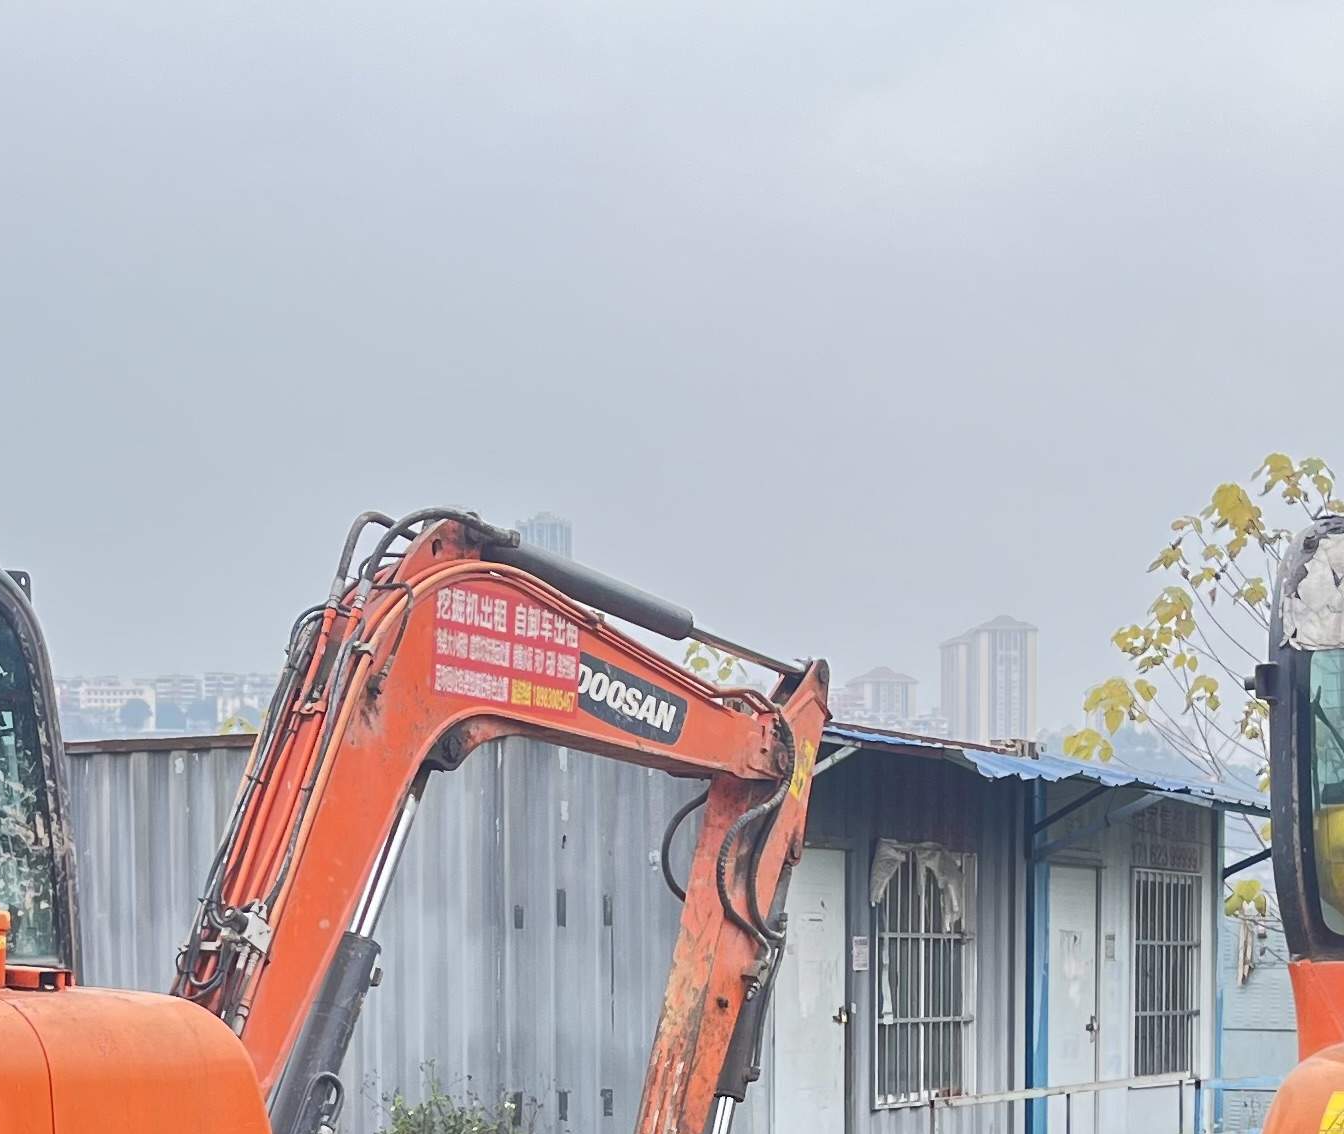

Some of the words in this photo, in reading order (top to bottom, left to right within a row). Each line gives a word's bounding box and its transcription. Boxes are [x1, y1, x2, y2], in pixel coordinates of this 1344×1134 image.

[436, 587, 507, 632] 挖掘机出租
[514, 602, 578, 648] 自卸车出租
[577, 663, 676, 732] DOOSAN
